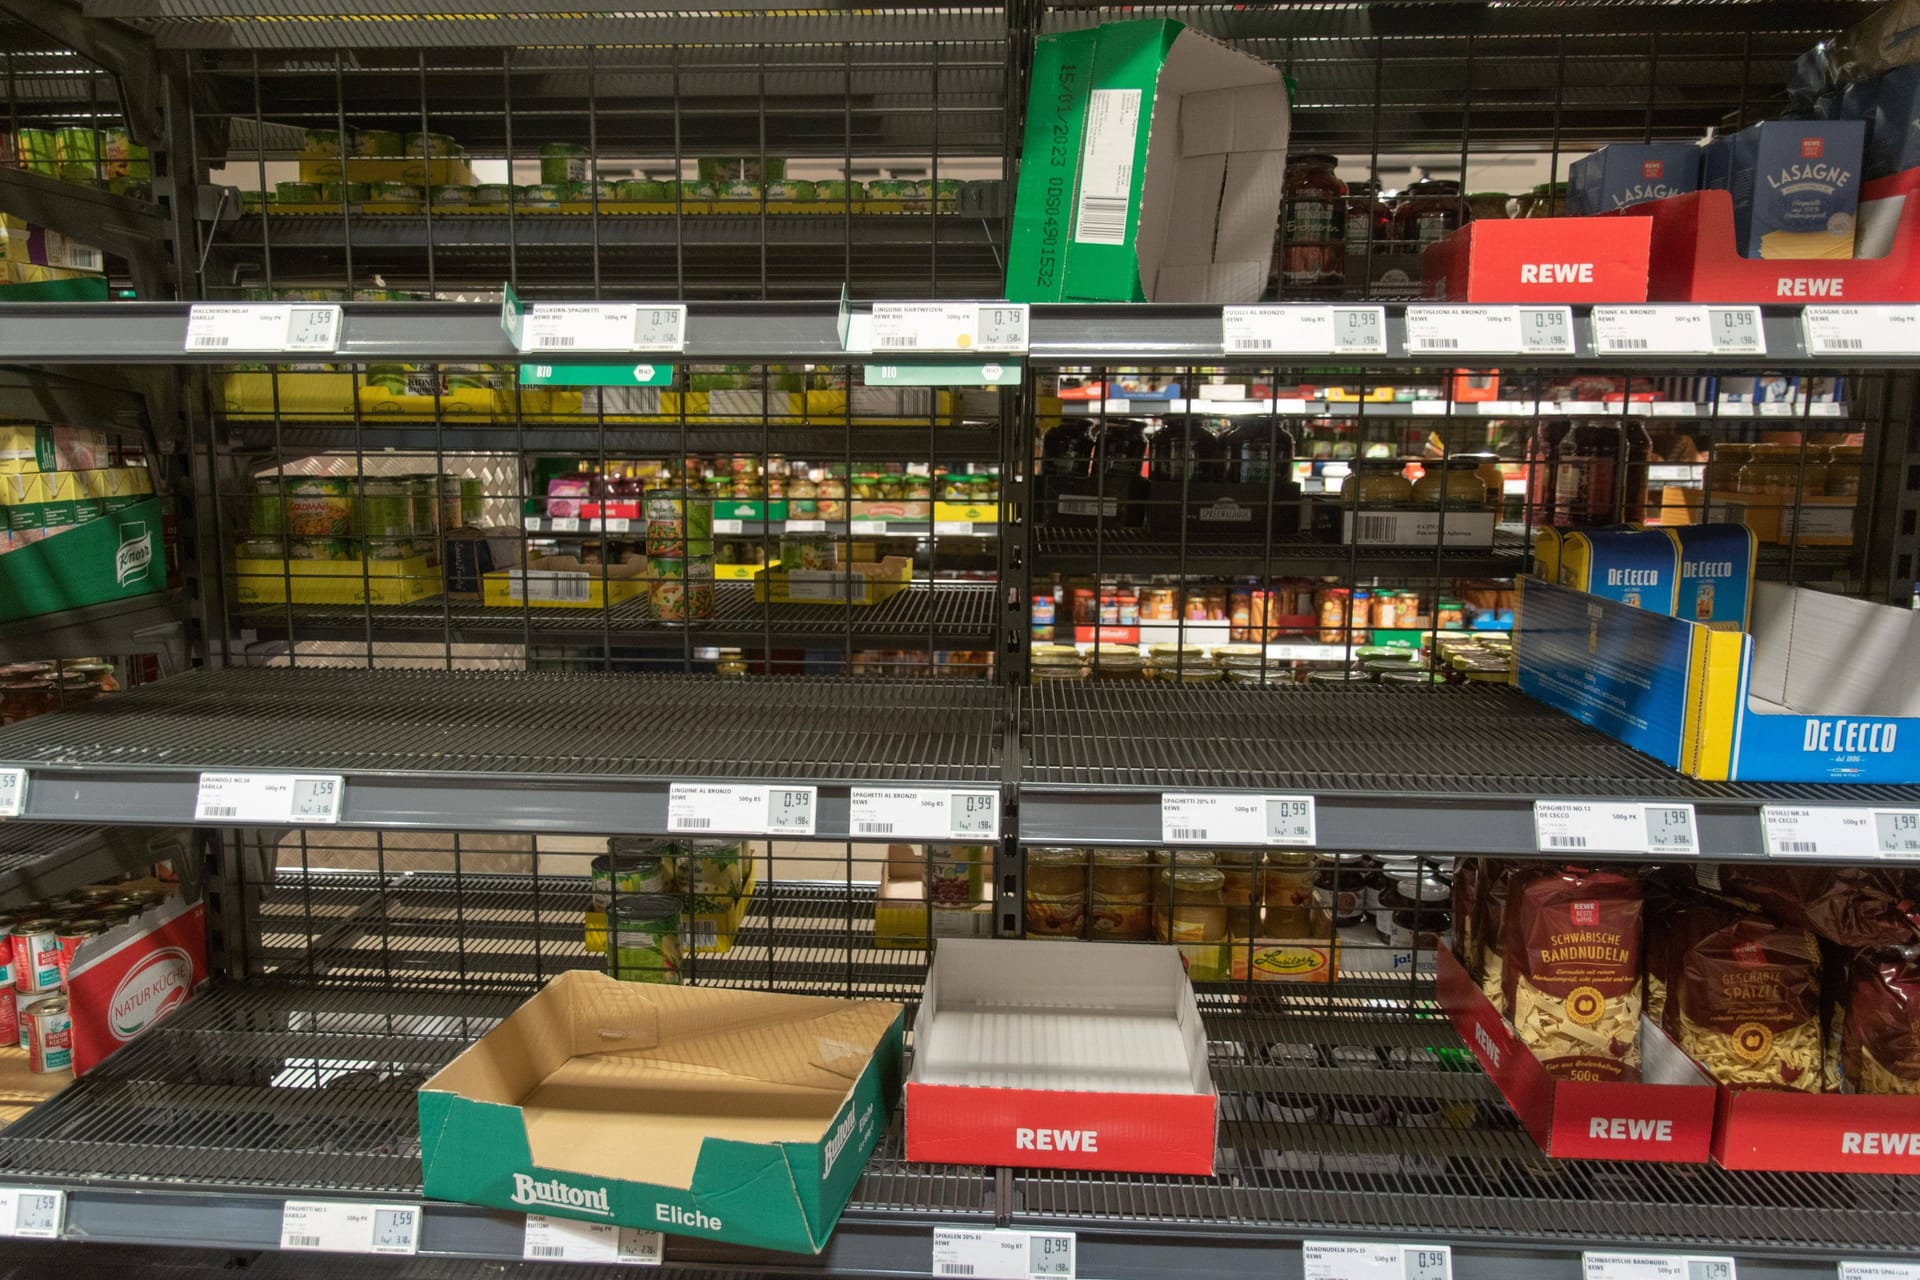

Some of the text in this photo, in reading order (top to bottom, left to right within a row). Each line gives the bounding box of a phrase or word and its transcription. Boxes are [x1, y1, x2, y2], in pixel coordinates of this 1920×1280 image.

[1767, 163, 1851, 189] LASAGNE
[1520, 263, 1593, 284] REWE
[1776, 278, 1843, 297] REWE
[536, 366, 552, 378] BIO
[882, 366, 896, 378] BIO
[120, 545, 150, 570] Knorr
[1683, 561, 1732, 578] DE CECCO
[1608, 568, 1658, 586] DE CECCO
[1803, 719, 1897, 753] DE CECCO
[1550, 929, 1622, 946] SCHWÄBISCHE
[1393, 952, 1412, 968] ja!
[1540, 946, 1630, 964] BANDNUDELN
[1722, 971, 1782, 984] GESCHABTE
[115, 964, 187, 1021] NATUR KÜCHE
[1474, 1021, 1500, 1069] REWE
[822, 1100, 856, 1180] Buitoni
[1016, 1127, 1098, 1152] REWE
[1588, 1117, 1673, 1142] REWE
[1841, 1132, 1920, 1156] REWE
[511, 1172, 610, 1211] Buitoni
[656, 1202, 723, 1231] Eliche
